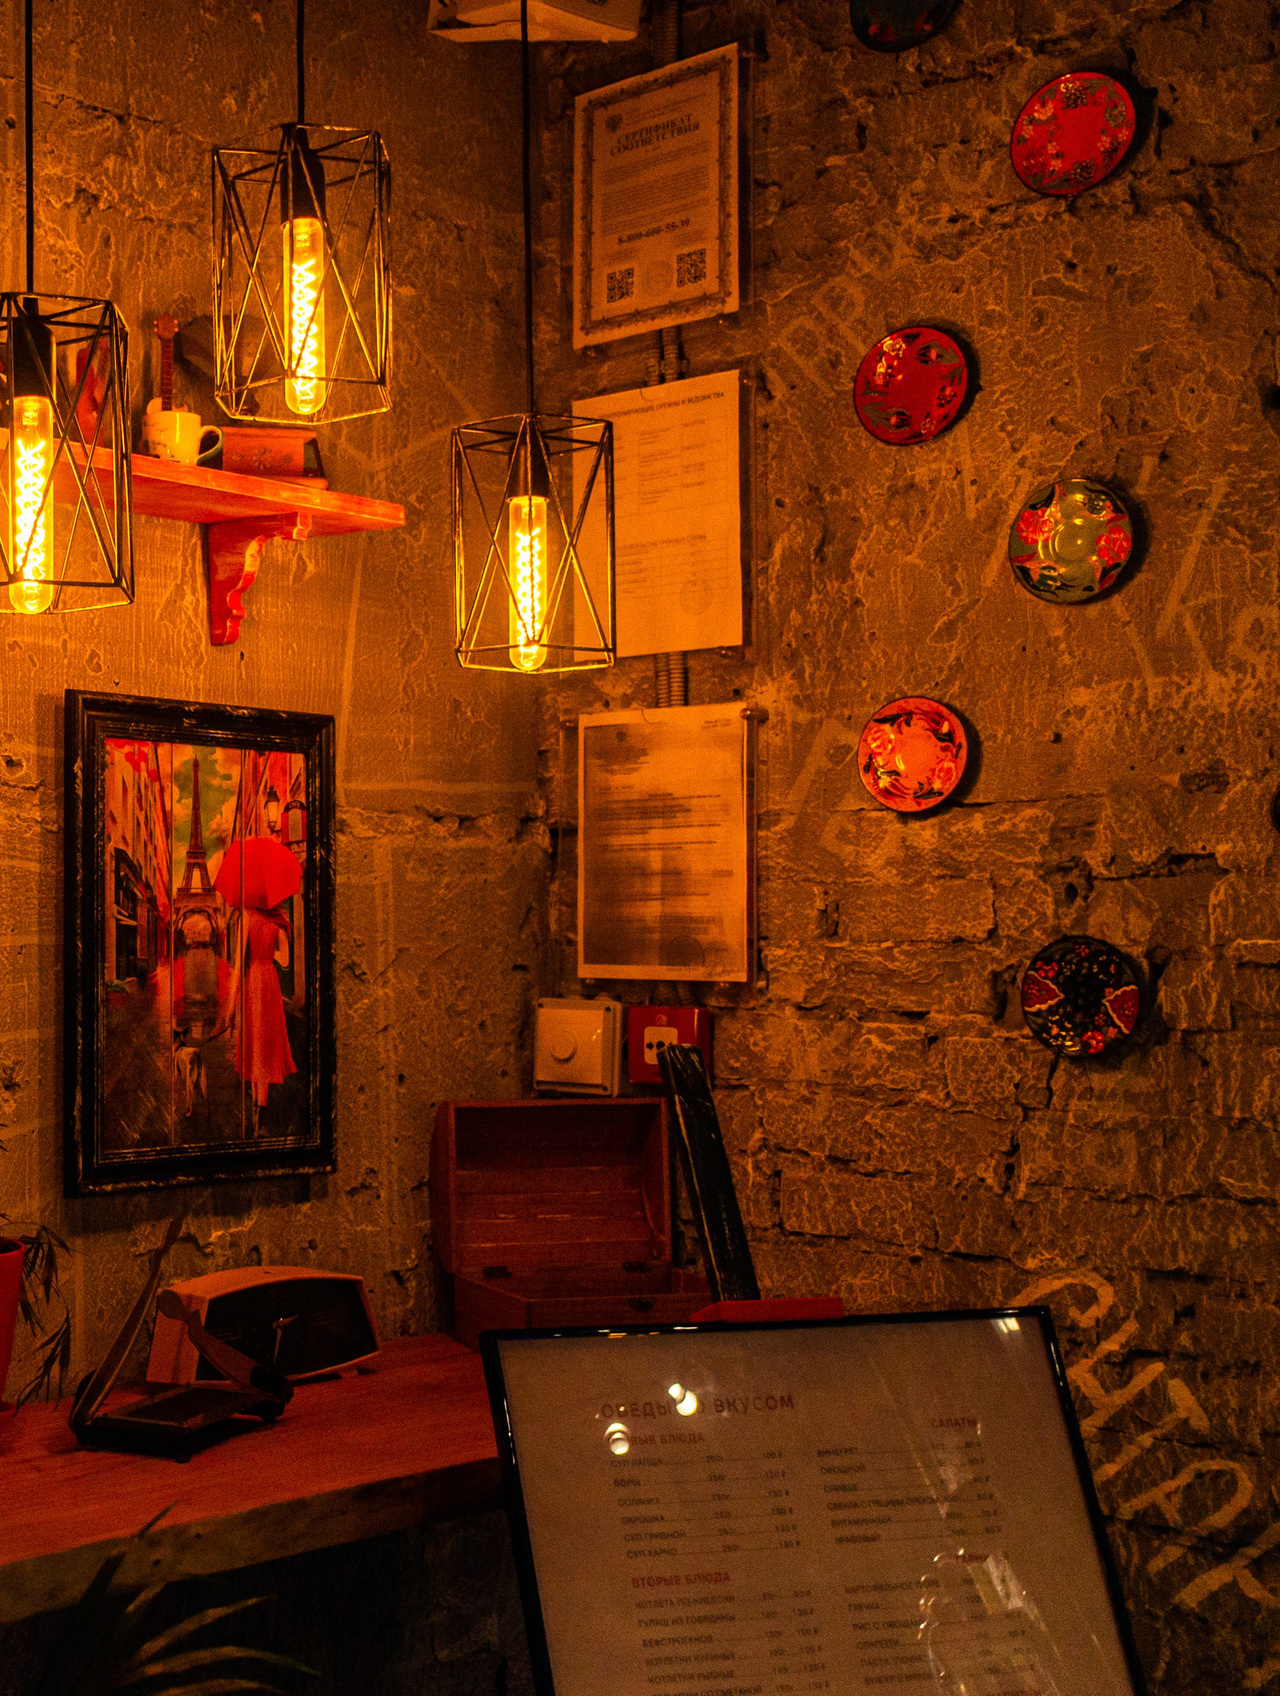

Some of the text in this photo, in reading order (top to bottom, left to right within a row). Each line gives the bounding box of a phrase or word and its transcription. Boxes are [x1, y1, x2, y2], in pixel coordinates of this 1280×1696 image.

[601, 1401, 671, 1420] ОБЕДЫ
[714, 1395, 794, 1412] ВКУСОМ
[930, 1417, 977, 1428] САЛАТЫ
[659, 1432, 704, 1444] БЛЮДА
[631, 1573, 730, 1587] ВТОРЫЕ БЛЮДА
